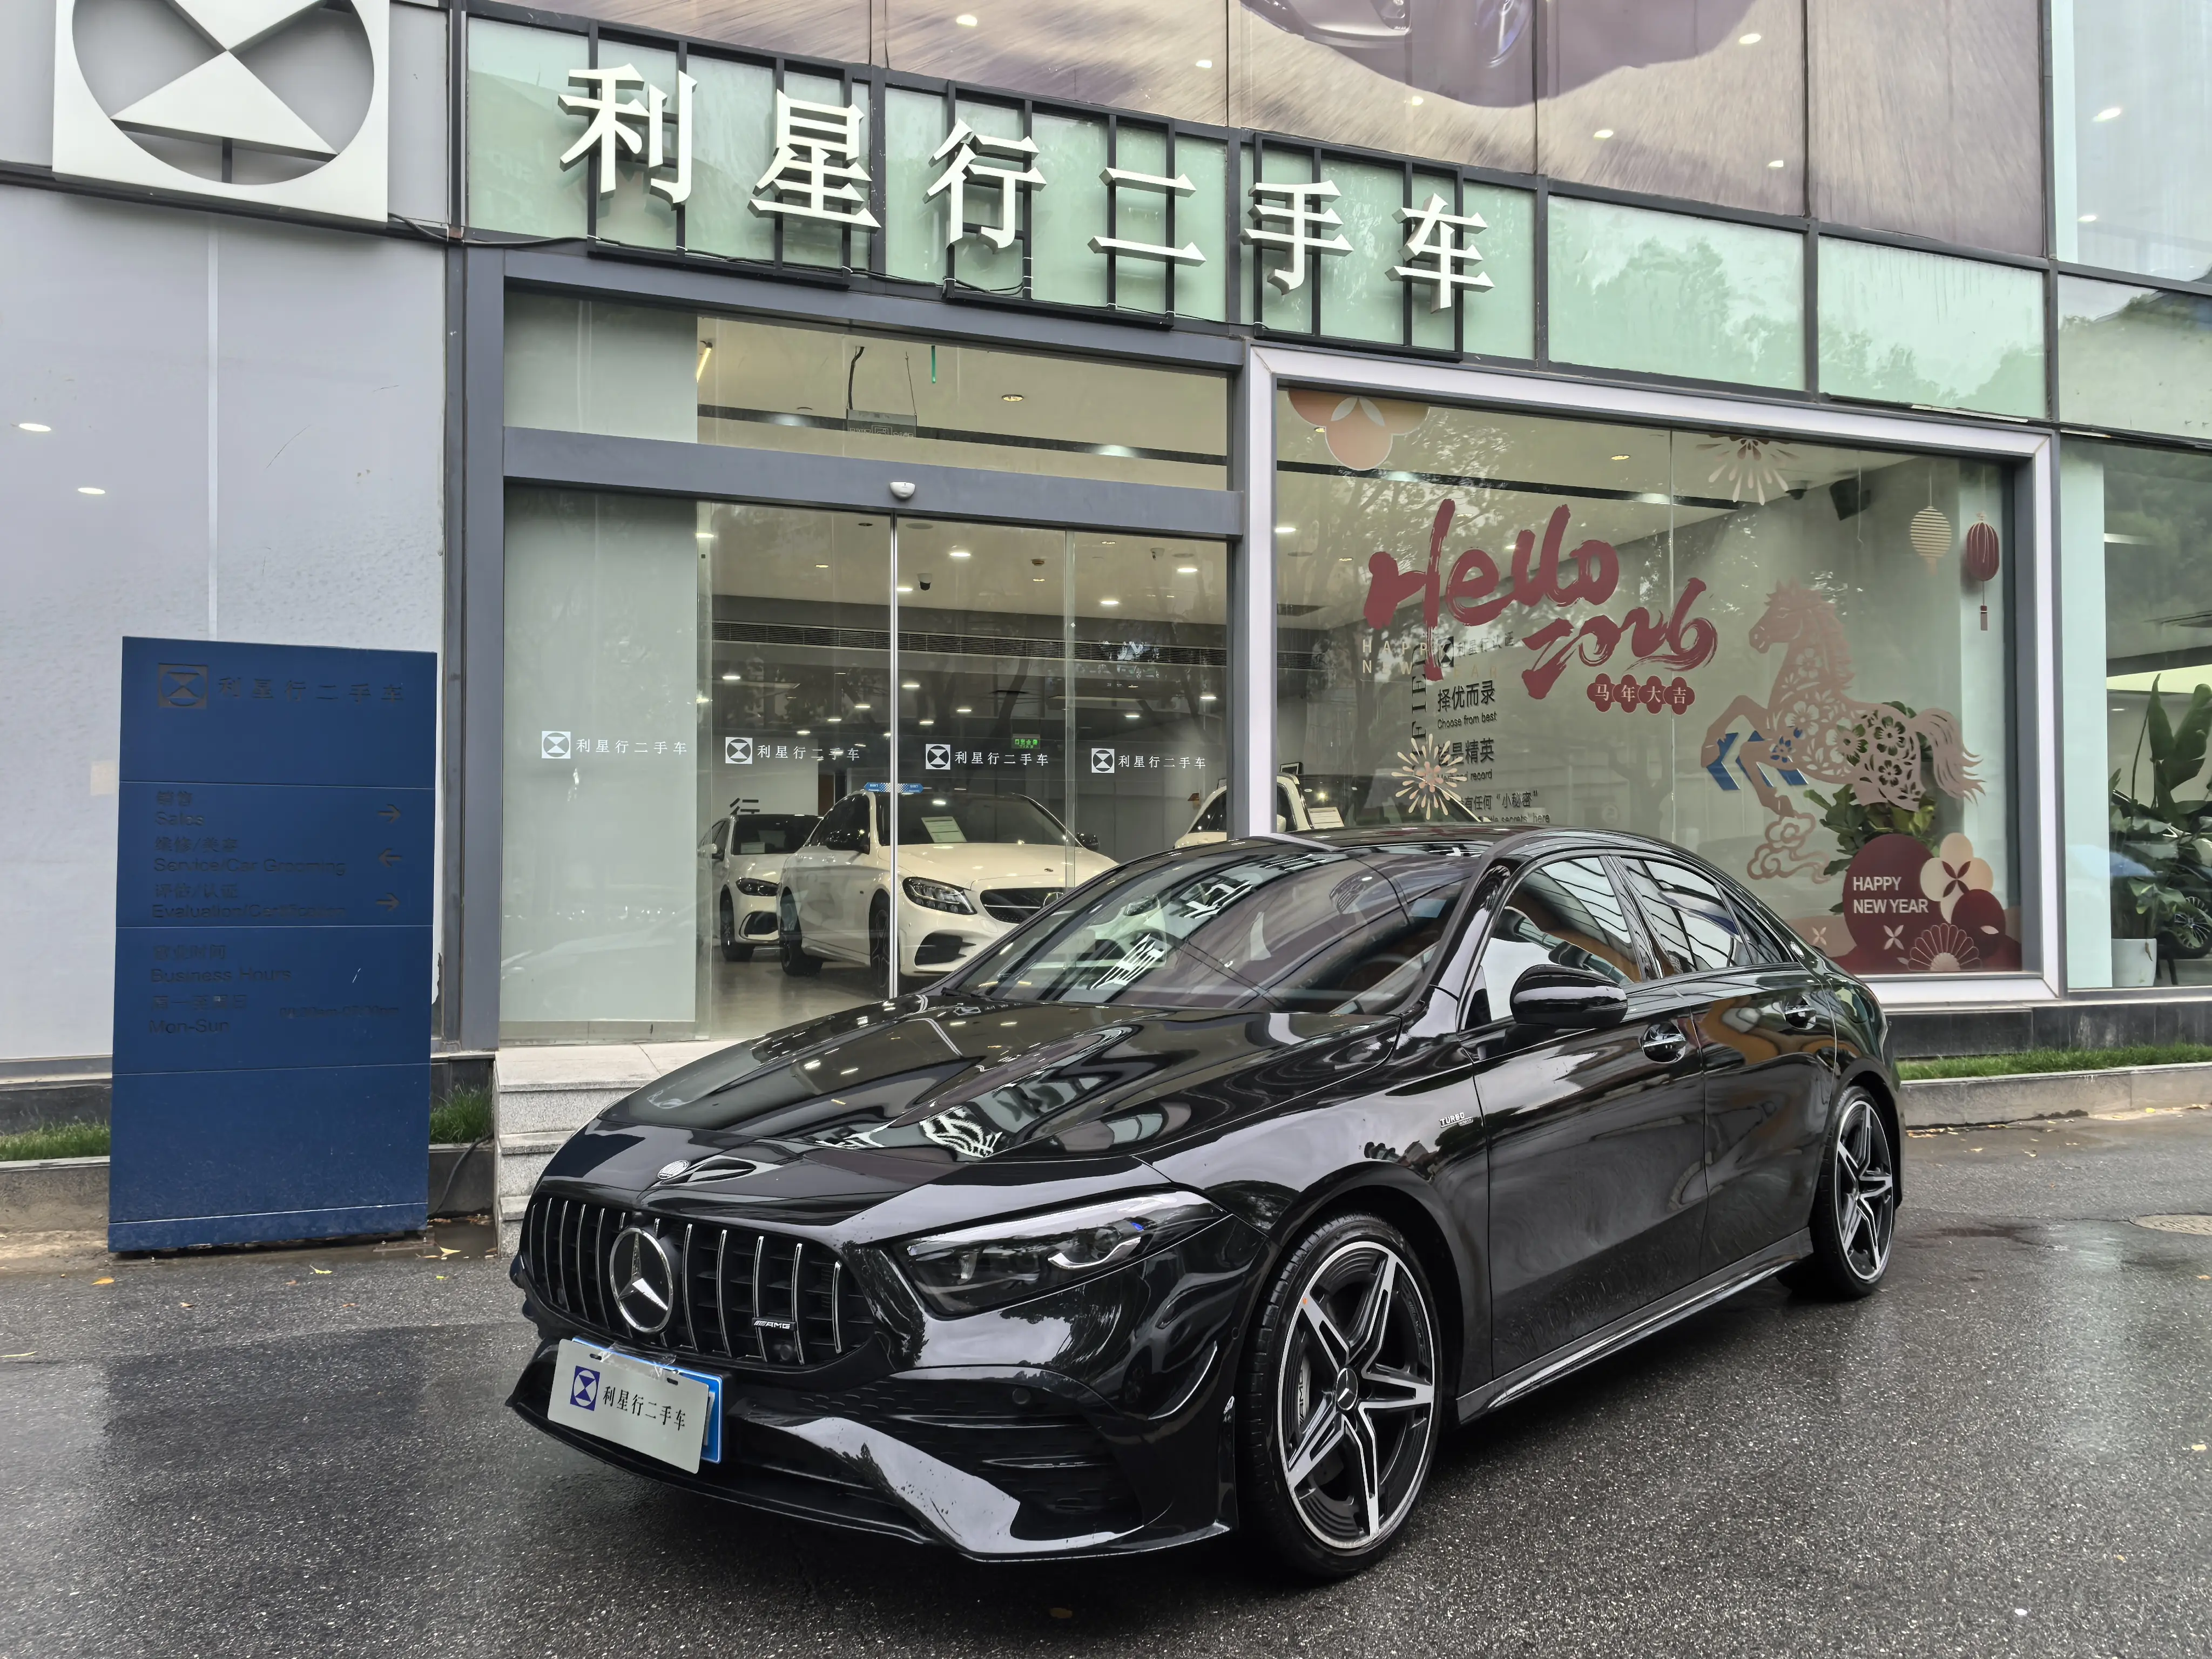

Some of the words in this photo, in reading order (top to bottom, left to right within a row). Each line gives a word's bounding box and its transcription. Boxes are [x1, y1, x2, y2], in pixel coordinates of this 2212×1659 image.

[558, 63, 1495, 313] 利星行二手车
[1363, 498, 1620, 681] Hello
[1453, 664, 1498, 679] EAR
[218, 676, 404, 703] 利星行二手车
[1437, 679, 1495, 712] 择优而录
[1594, 683, 1688, 707] 马年大吉
[1438, 718, 1461, 729] Choose
[1464, 714, 1479, 725] from
[1481, 711, 1498, 722] best
[576, 738, 687, 756] 利星行二手车
[757, 744, 859, 761] 利星行二手车
[954, 751, 1049, 766] 利星行二手车
[1118, 754, 1206, 770] 利星行二手车
[1470, 768, 1493, 781] record
[154, 811, 205, 826] Sales
[1533, 812, 1550, 823] here
[1853, 876, 1902, 891] HAPPY
[1853, 899, 1887, 914] NEW
[1890, 899, 1929, 913] YEAR
[151, 968, 232, 983] Business
[239, 966, 292, 982] Hours
[149, 1019, 229, 1034] Mon-Sun
[1439, 1111, 1465, 1126] TURBO
[765, 1321, 791, 1329] AMG
[603, 1385, 686, 1431] 利星行二手车
